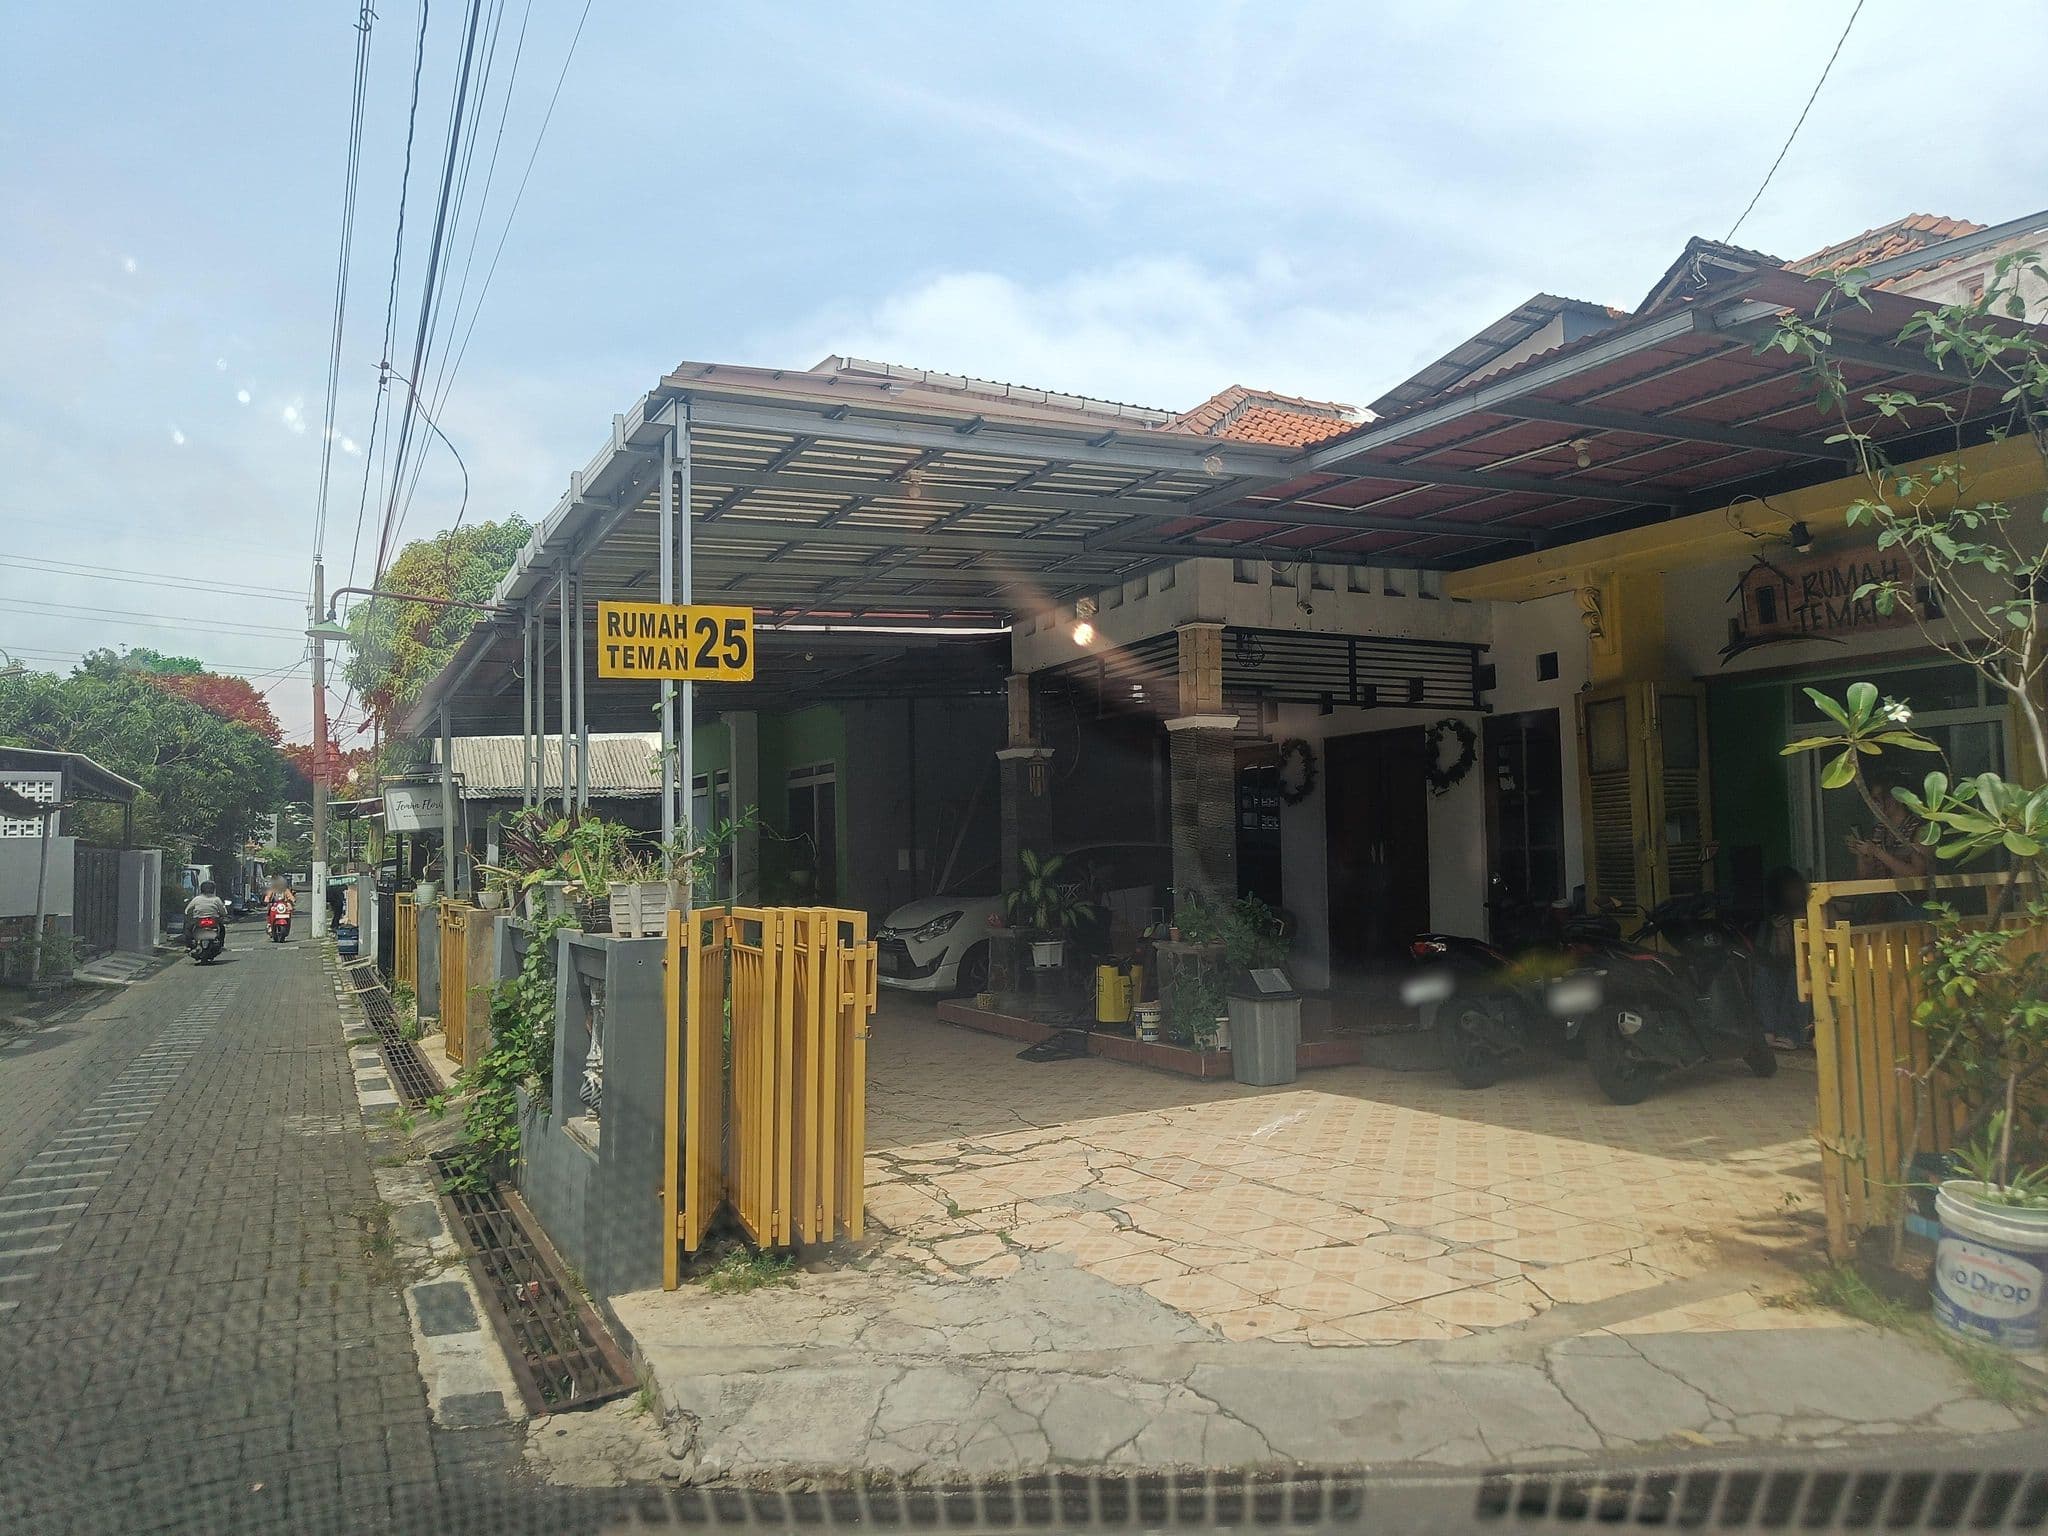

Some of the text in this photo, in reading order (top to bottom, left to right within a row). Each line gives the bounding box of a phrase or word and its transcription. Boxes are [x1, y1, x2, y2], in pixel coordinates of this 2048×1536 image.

[1801, 558, 1899, 602] RUMAH
[607, 611, 688, 639] RUMAH
[607, 645, 688, 671] TEMAN
[694, 617, 748, 670] 25
